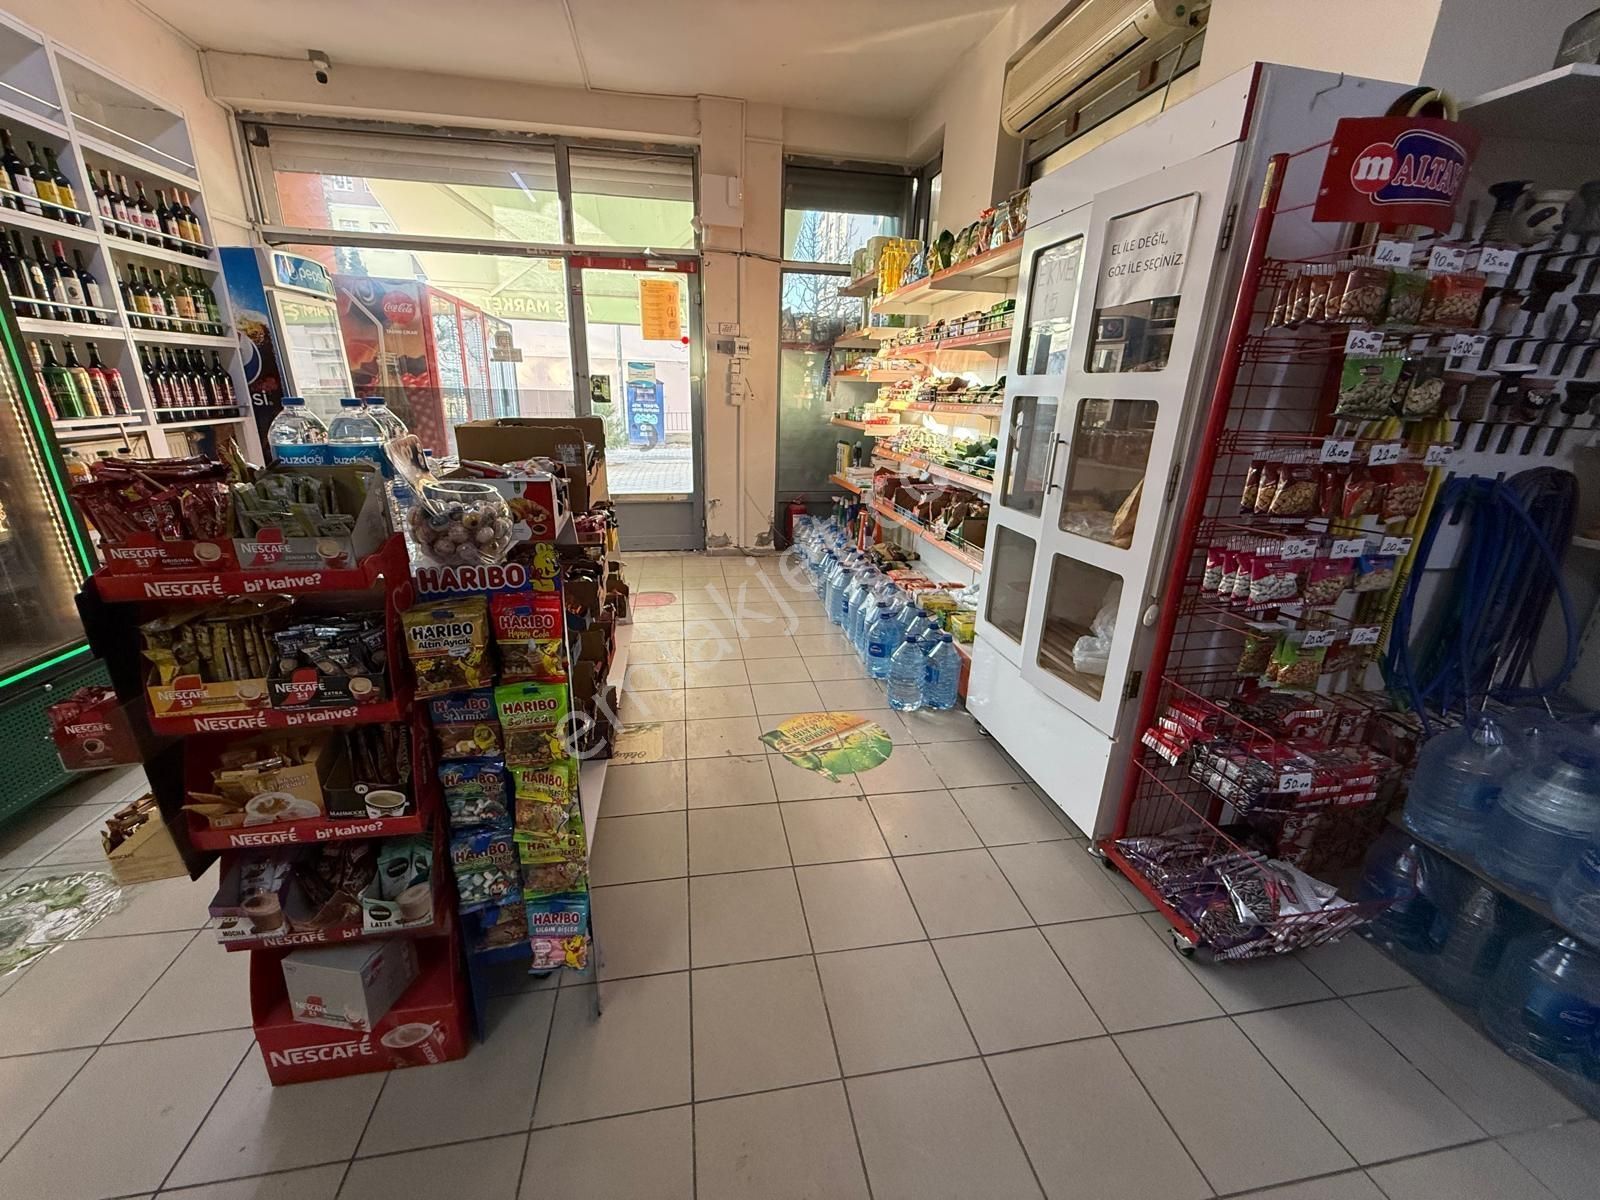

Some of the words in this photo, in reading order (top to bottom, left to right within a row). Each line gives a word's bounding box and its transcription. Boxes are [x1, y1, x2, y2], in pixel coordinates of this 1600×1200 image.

[1111, 243, 1121, 256] EL
[1122, 238, 1135, 253] İLE
[1137, 230, 1169, 250] DEĞİL,
[1127, 260, 1142, 274] İLE
[1143, 251, 1184, 271] SEÇİNİZ.
[144, 576, 224, 598] NESCAFÉ
[266, 573, 323, 591] kahve?
[416, 563, 526, 593] HARIBO
[412, 622, 475, 642] HARIBO
[500, 614, 554, 630] HARIBO
[502, 698, 558, 715] HARIBO
[194, 711, 267, 732] NESCAFÉ
[307, 706, 359, 724] kahve?
[522, 770, 563, 787] HARIBO
[230, 826, 298, 847] NESCAFÉ
[335, 821, 384, 837] kahve?
[370, 921, 393, 929] LATTE
[533, 912, 581, 926] HARIBO
[222, 929, 246, 938] MOCHA
[263, 929, 328, 947] NESCAFÉ
[269, 1034, 374, 1068] NESCAFÉ
